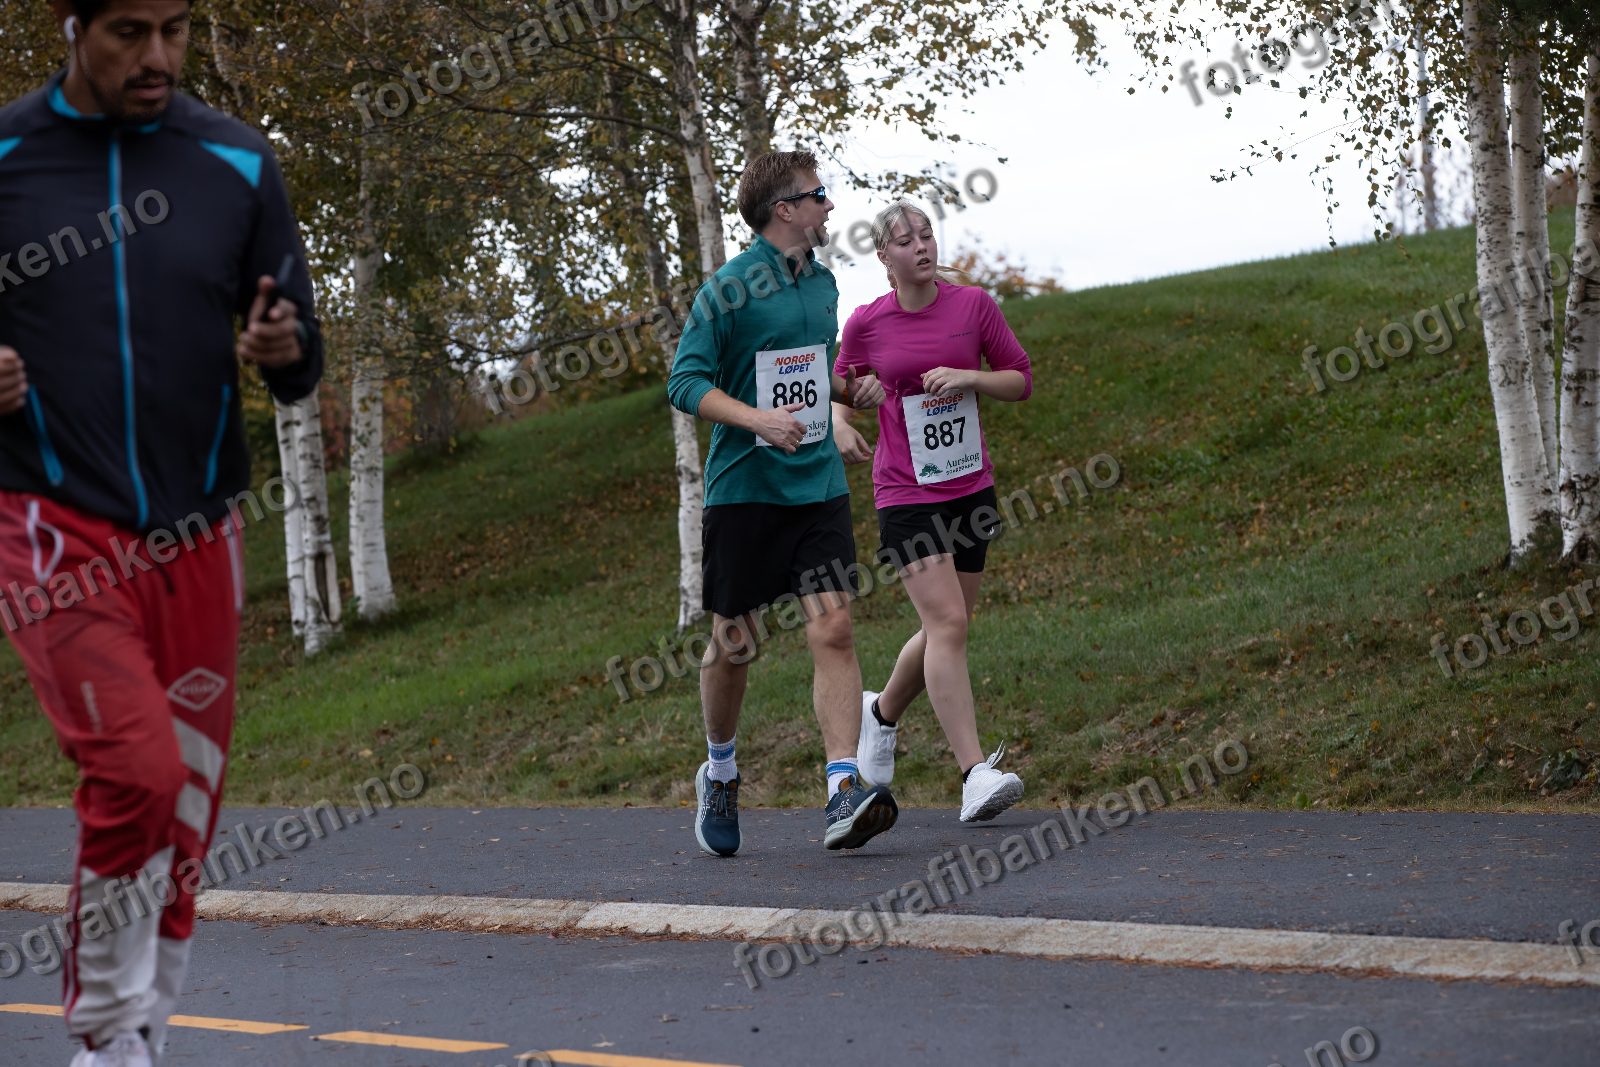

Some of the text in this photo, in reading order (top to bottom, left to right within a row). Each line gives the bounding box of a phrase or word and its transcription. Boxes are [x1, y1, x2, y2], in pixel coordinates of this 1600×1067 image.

[774, 353, 816, 366] NORGES
[779, 363, 811, 375] LØPET
[772, 379, 818, 409] 886
[921, 393, 964, 409] NORGES
[927, 403, 959, 416] LØPET
[806, 420, 828, 431] skog
[923, 416, 966, 451] 887
[946, 452, 980, 469] Aurskog
